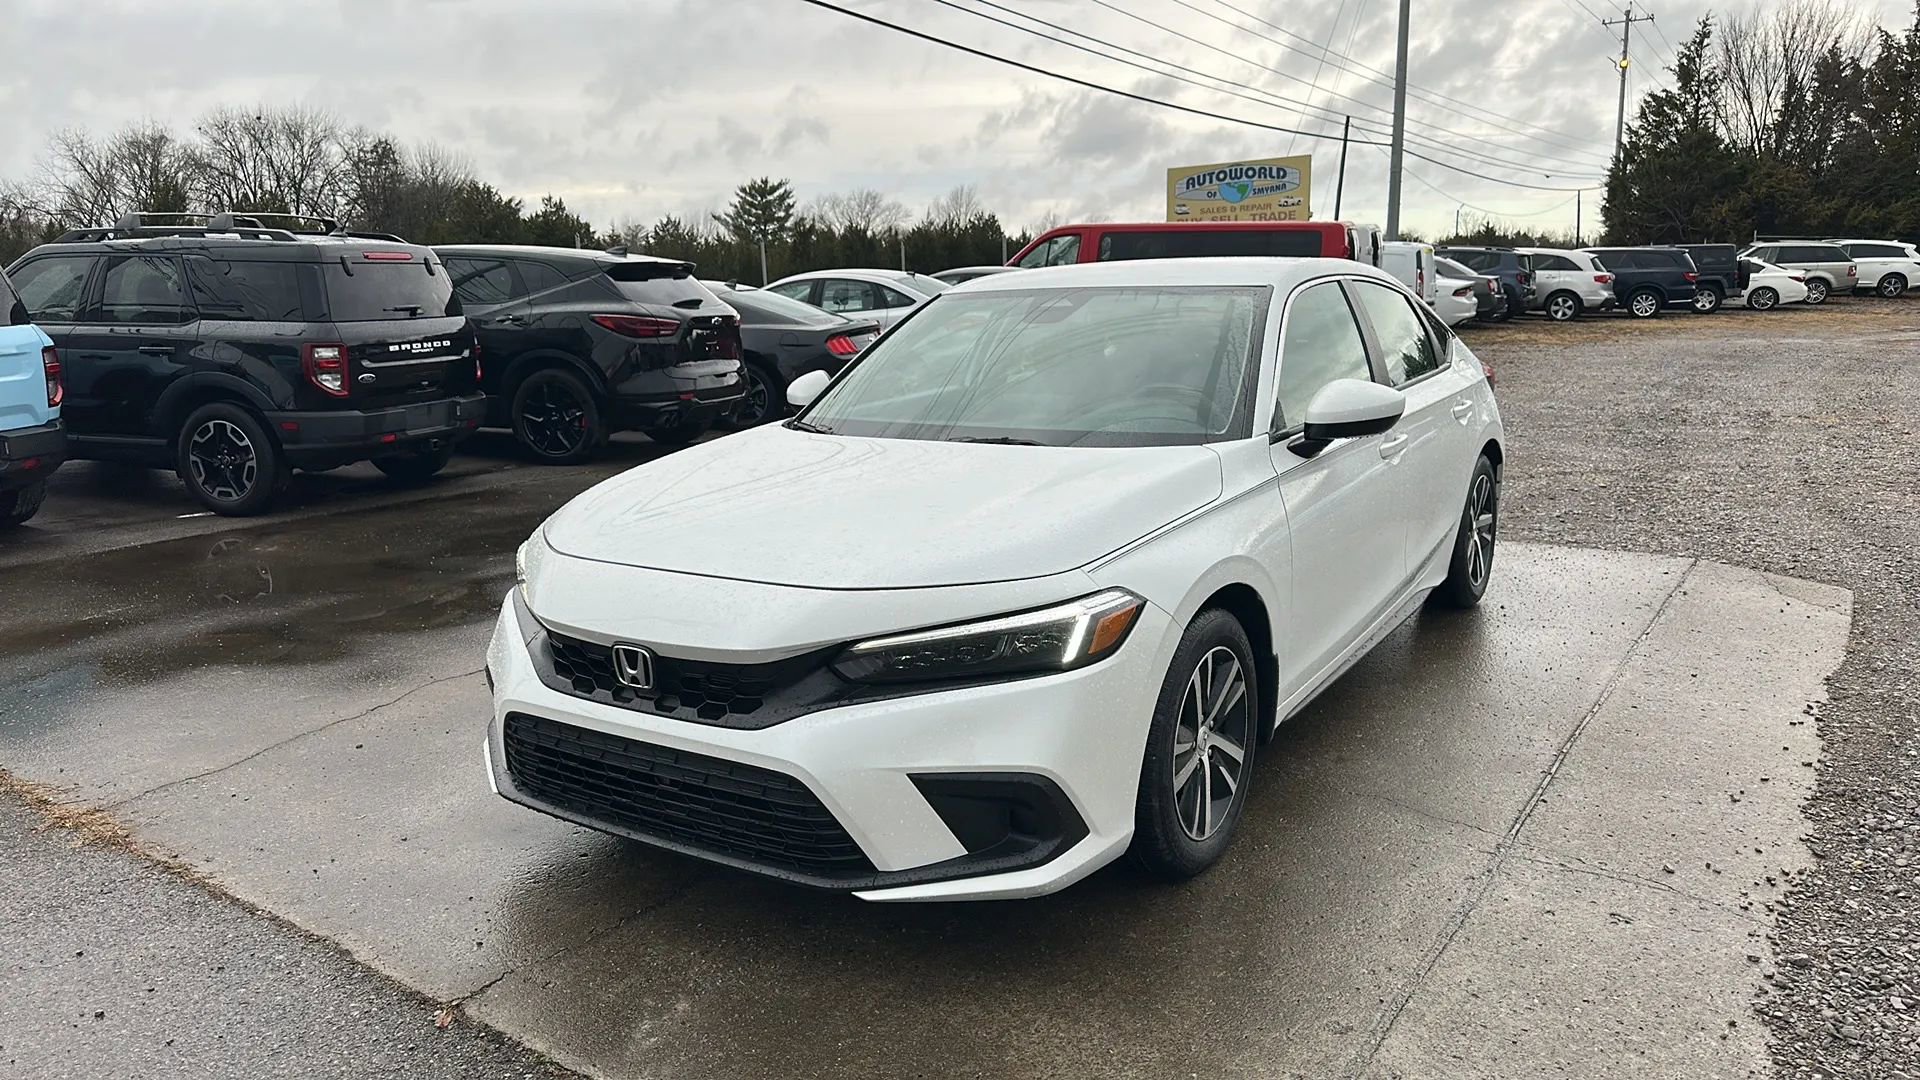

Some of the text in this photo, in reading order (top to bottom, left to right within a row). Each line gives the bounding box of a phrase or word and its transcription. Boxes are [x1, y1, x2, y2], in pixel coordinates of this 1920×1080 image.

[1186, 166, 1288, 190] AUTOWORLD
[1206, 183, 1287, 199] OF SMYRNA
[1200, 206, 1228, 216] SALES
[1240, 203, 1272, 213] REPAIR
[1250, 210, 1297, 221] TRADE
[389, 340, 451, 351] BRONCO
